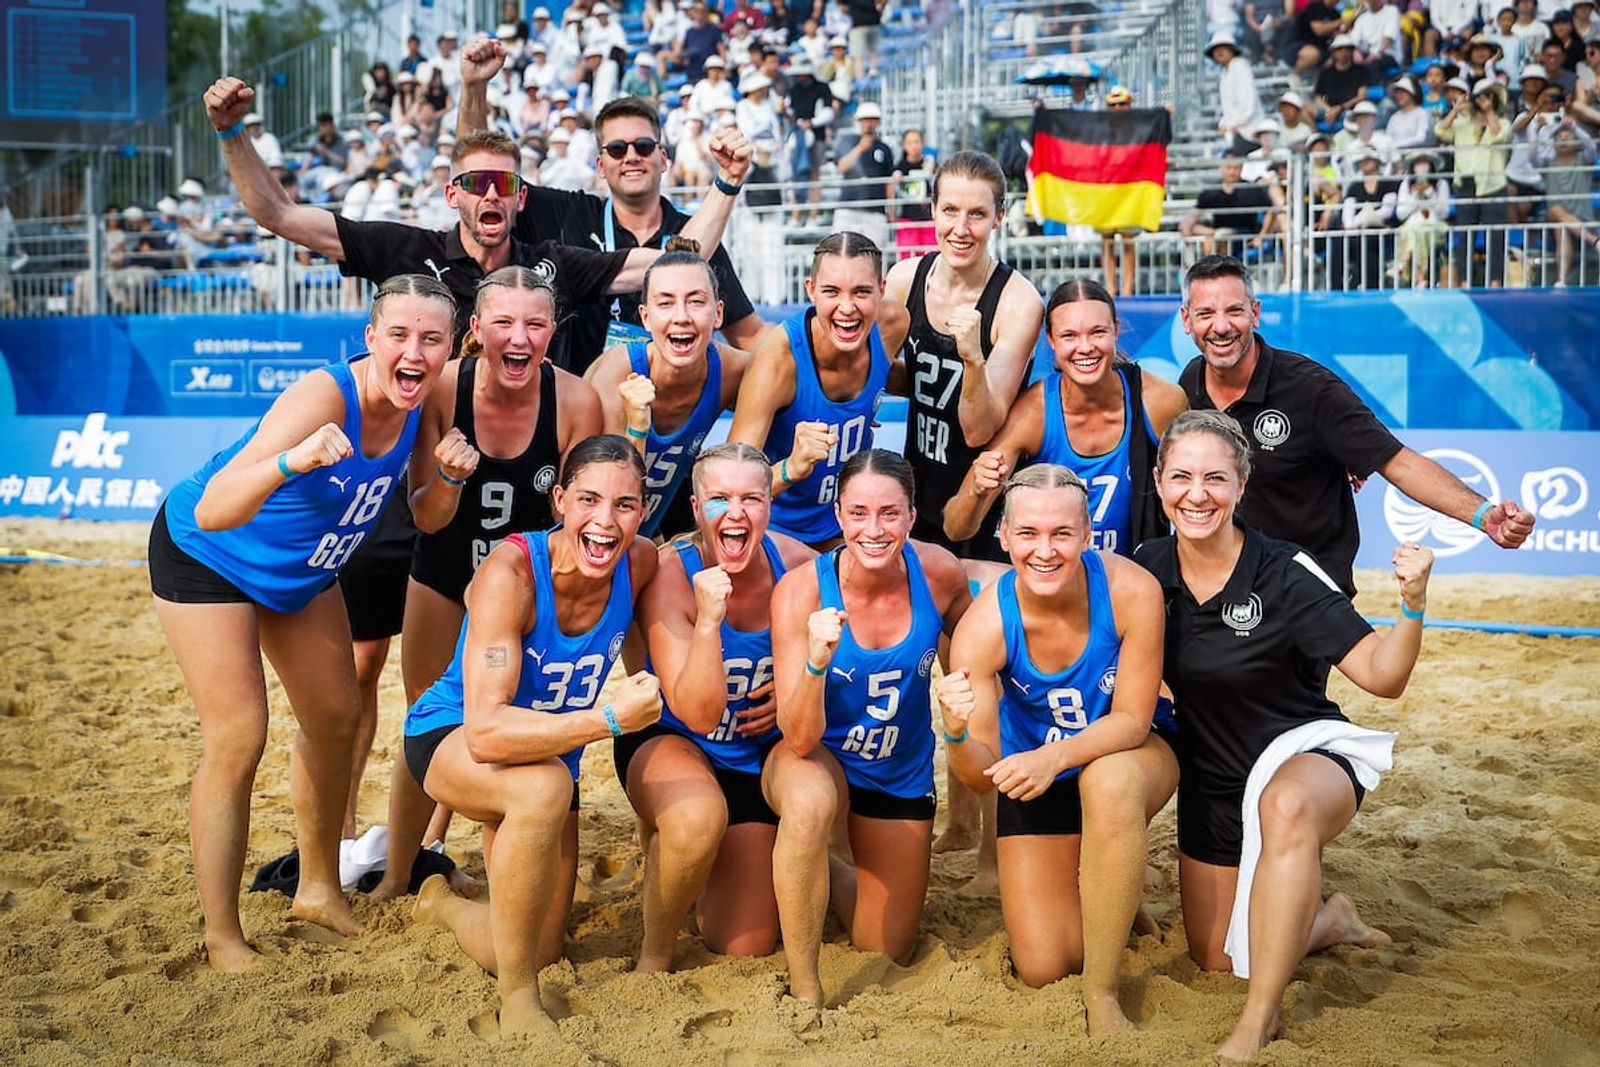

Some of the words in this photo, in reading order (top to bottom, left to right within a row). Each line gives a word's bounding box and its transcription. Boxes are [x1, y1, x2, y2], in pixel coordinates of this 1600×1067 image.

[915, 352, 963, 410] 27
[827, 415, 866, 467] 10
[917, 412, 949, 464] GER
[338, 476, 393, 526] 18
[481, 482, 514, 529] 9
[1078, 474, 1119, 522] 7
[1089, 529, 1118, 554] ER
[531, 654, 605, 710] 33
[866, 669, 903, 721] 5
[1047, 688, 1088, 729] 8
[842, 724, 900, 760] GER
